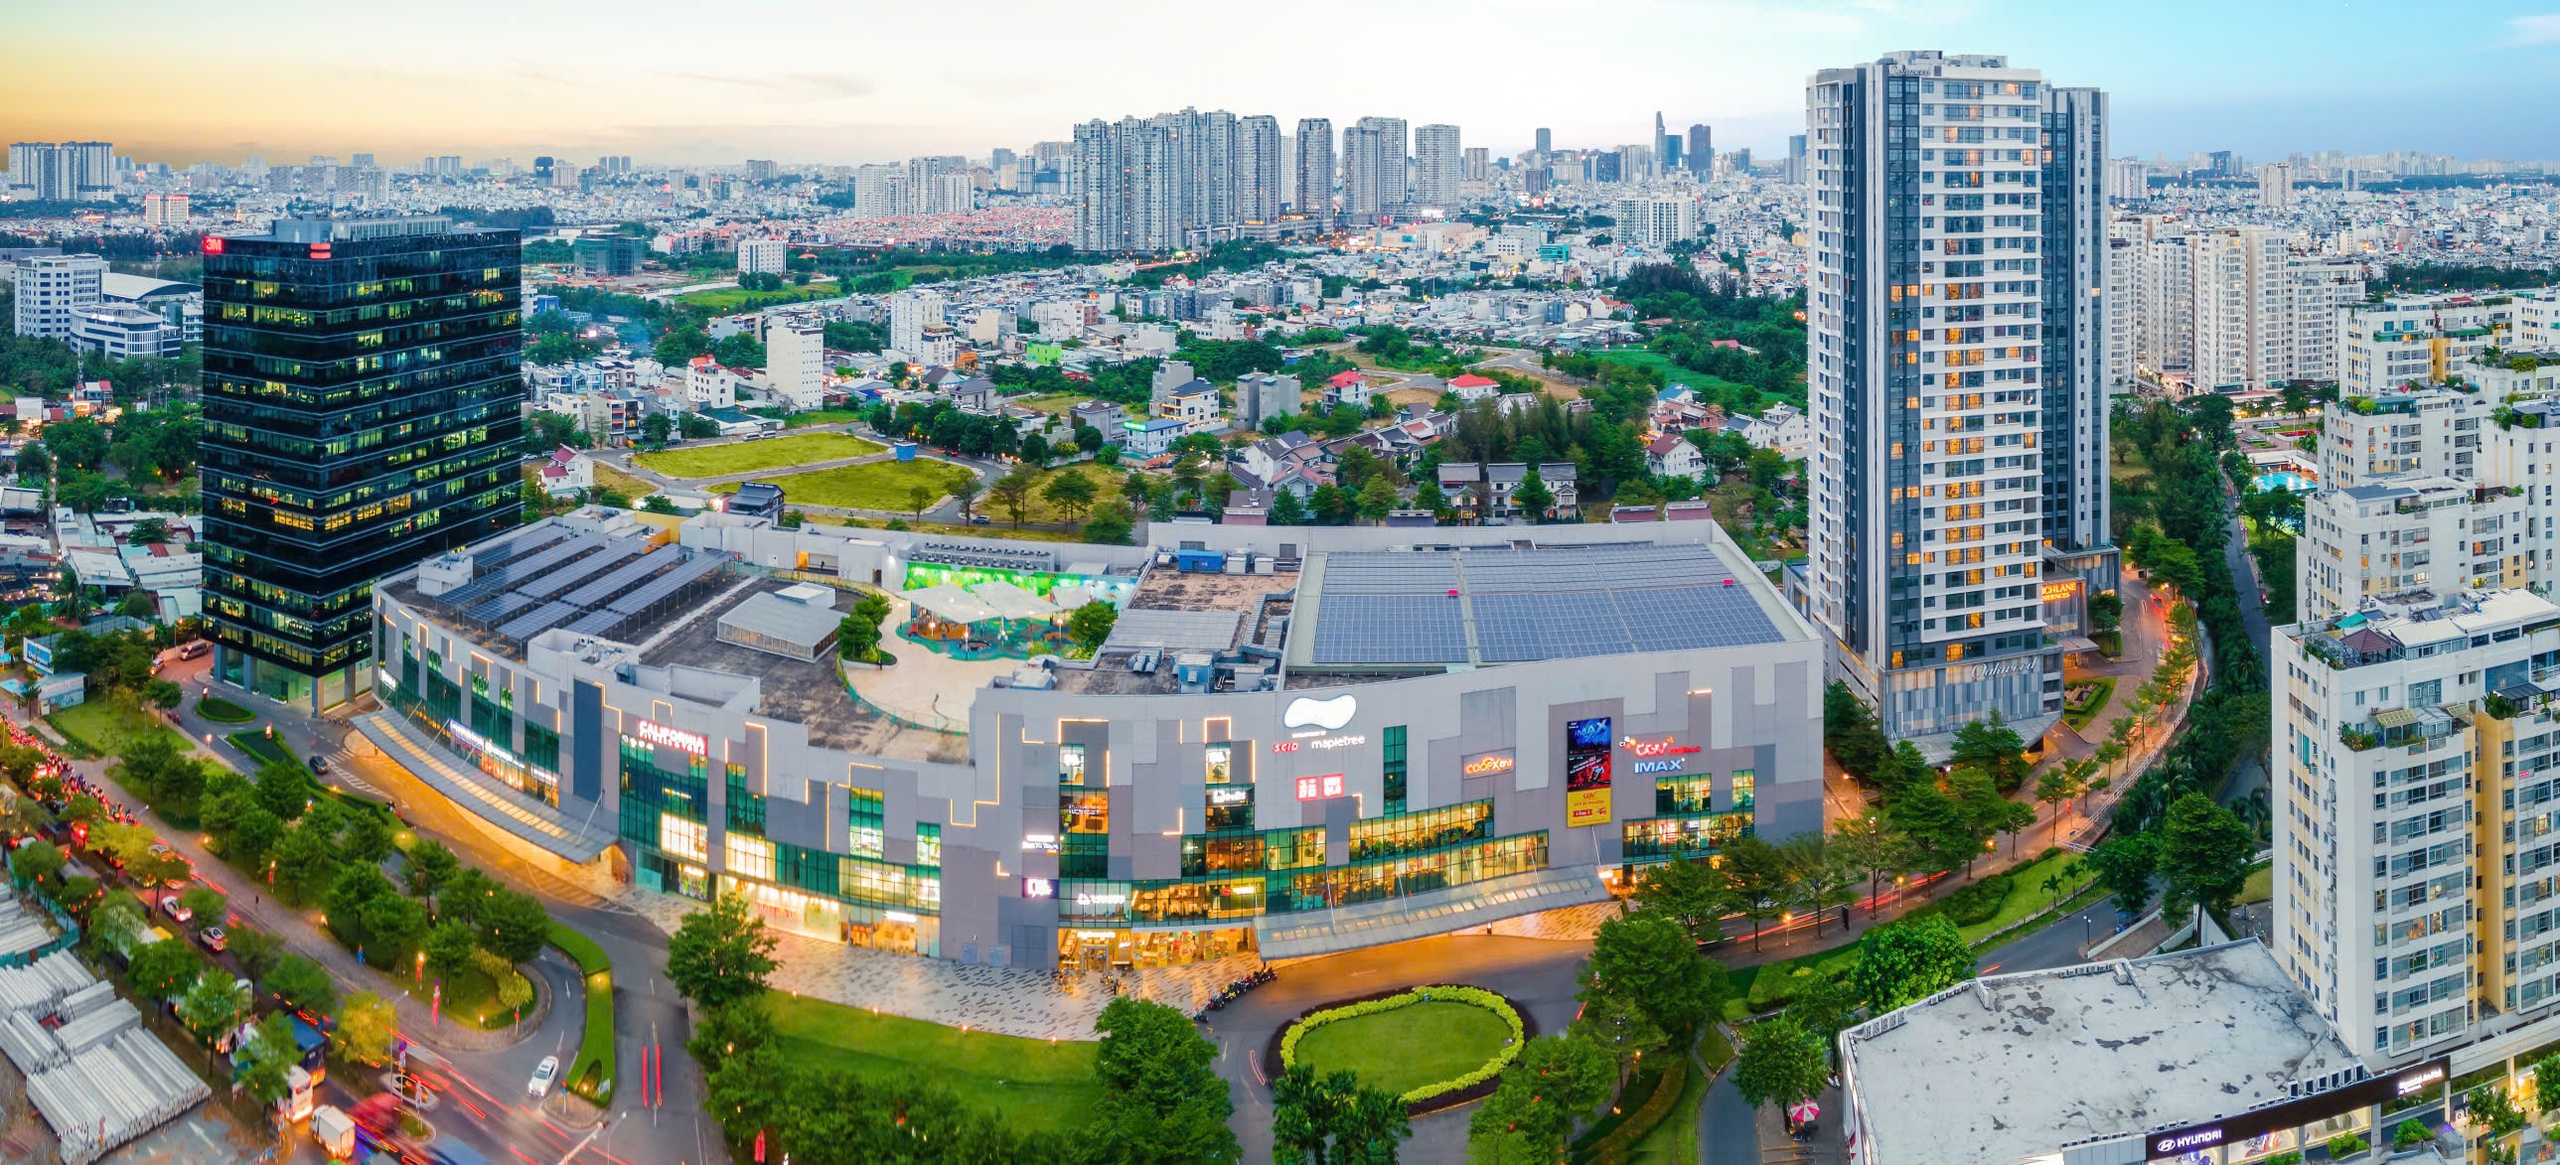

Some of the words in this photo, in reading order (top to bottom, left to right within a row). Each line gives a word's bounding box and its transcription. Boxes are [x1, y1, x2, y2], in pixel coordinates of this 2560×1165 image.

[206, 239, 222, 251] 3M
[2042, 582, 2076, 596] ICHLANE
[1971, 656, 2039, 679] Oakwood
[639, 720, 705, 748] CALIFORNIA
[1273, 742, 1299, 752] SCID
[1311, 735, 1366, 750] mapletree
[1636, 742, 1668, 758] CGV
[1634, 759, 1682, 774] IMAX
[2177, 1129, 2222, 1147] HYUNDAI
